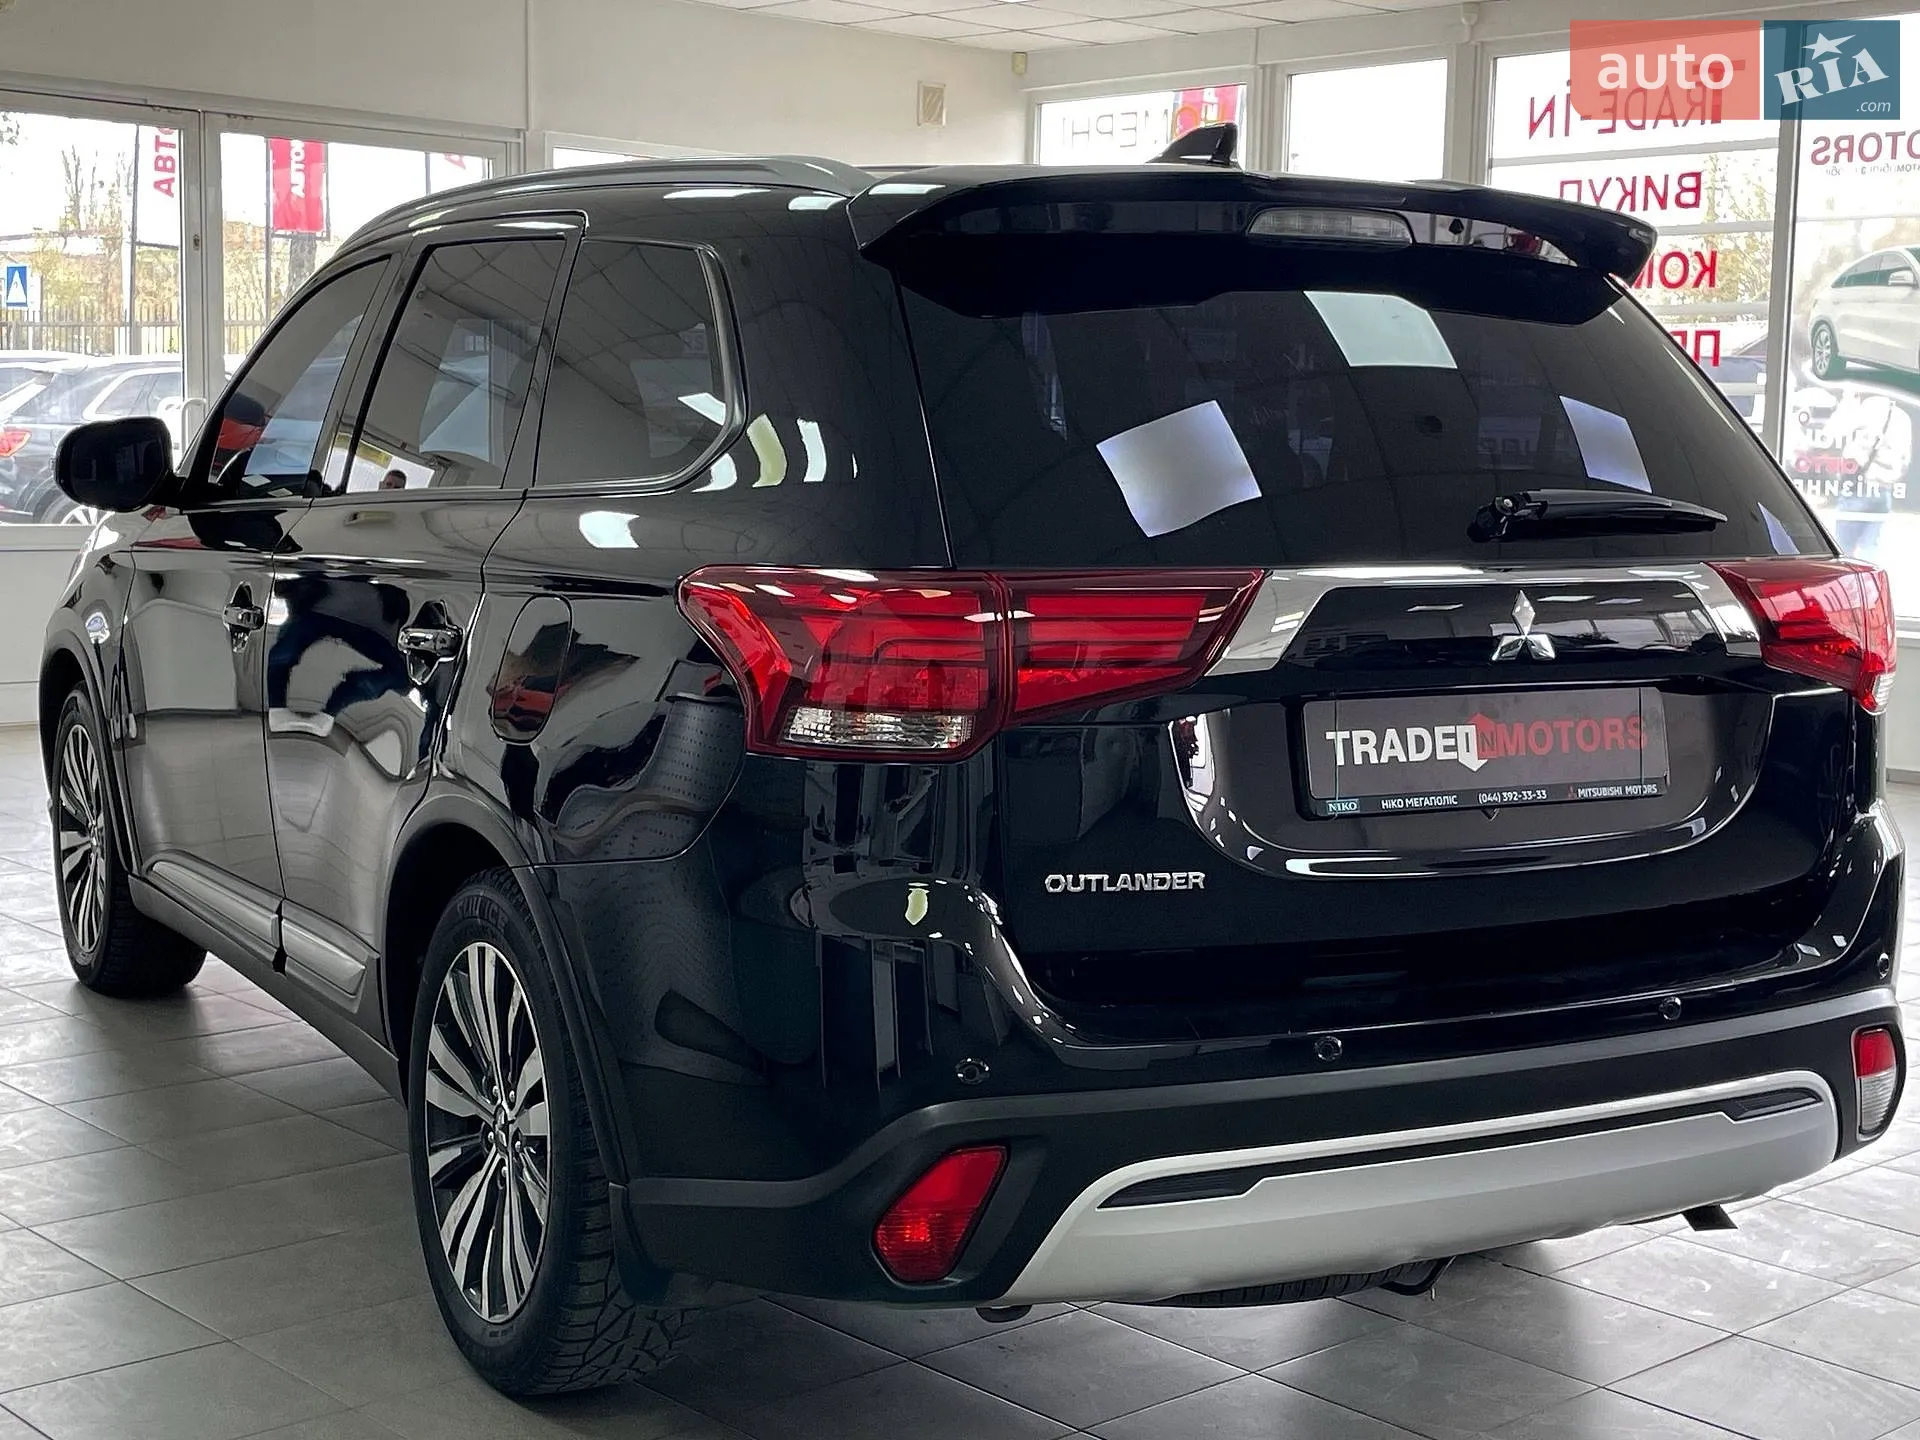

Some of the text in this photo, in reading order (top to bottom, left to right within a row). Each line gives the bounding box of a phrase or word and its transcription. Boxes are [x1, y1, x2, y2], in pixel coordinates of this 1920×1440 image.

[1325, 725, 1458, 766] TRADE
[1499, 715, 1648, 757] MOTORS
[1478, 789, 1547, 804] (044) 392-33-33
[1577, 786, 1623, 799] MITSUBISHI
[1328, 801, 1357, 812] NIKO
[1381, 795, 1458, 810] НІКО МЕГАПОЛІС
[1044, 871, 1206, 893] OUTLANDER
